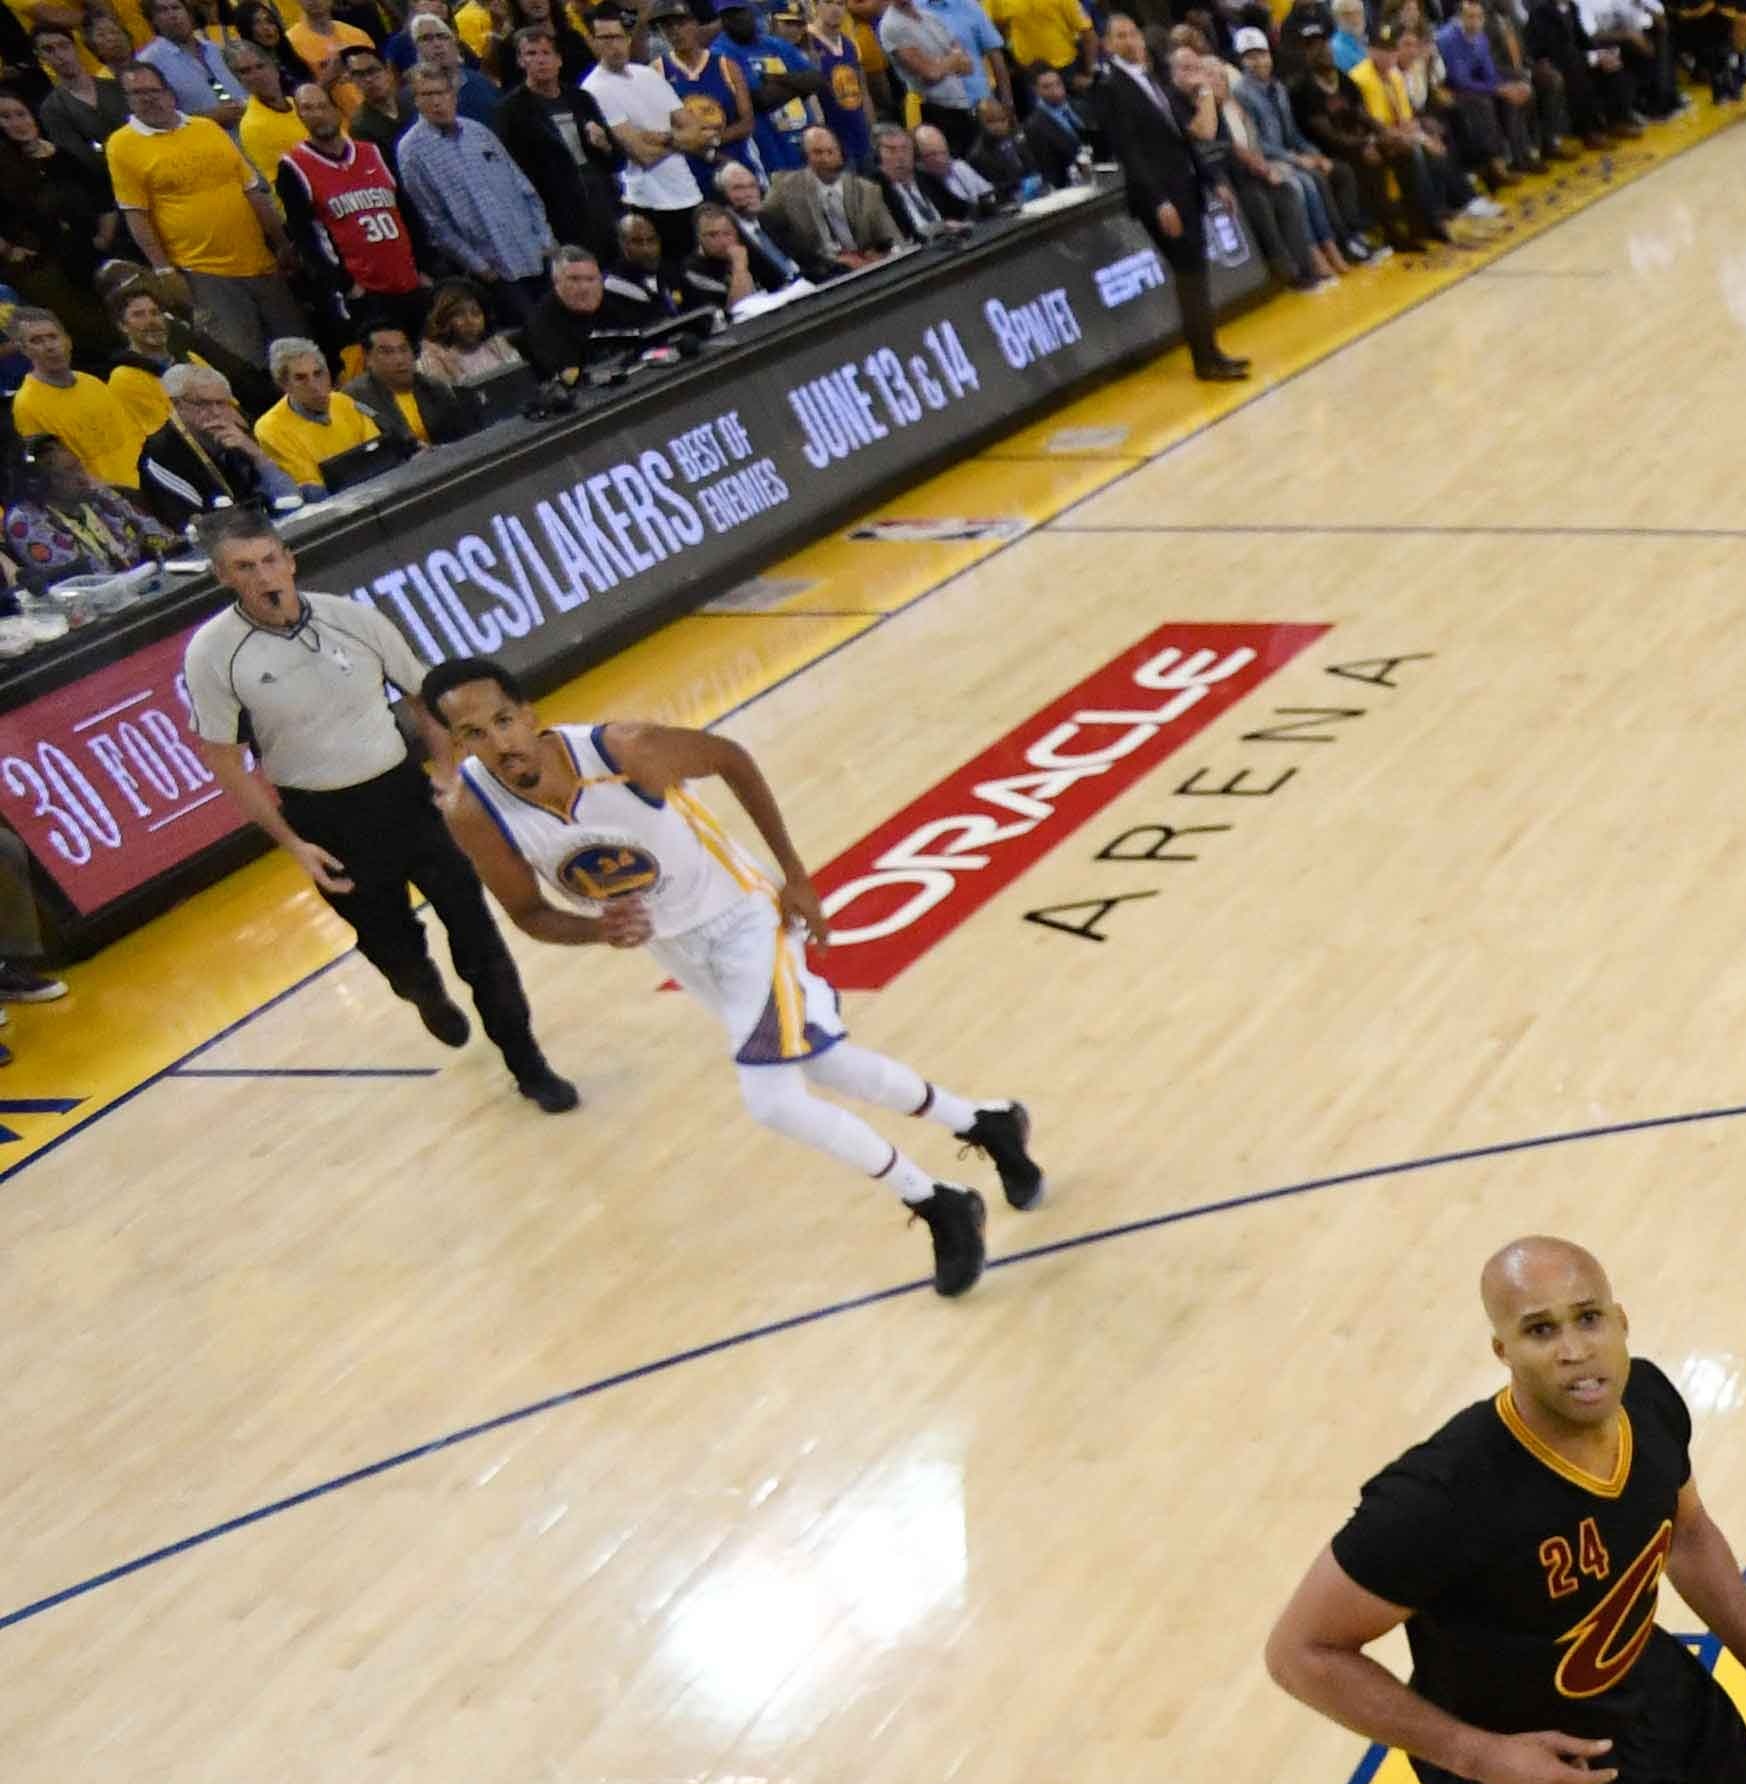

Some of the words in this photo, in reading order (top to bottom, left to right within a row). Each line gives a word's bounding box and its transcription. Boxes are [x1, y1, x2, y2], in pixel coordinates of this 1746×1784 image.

[328, 187, 397, 219] DAVIDSON
[358, 212, 400, 243] 30
[1093, 248, 1167, 310] ESPN
[864, 346, 923, 428] 13
[908, 354, 950, 412] &
[922, 319, 981, 400] 14
[788, 362, 889, 469] JUNE
[696, 457, 790, 533] ENEMIES
[353, 449, 705, 667] TICS/LAKERS
[666, 421, 729, 483] BEST
[716, 409, 754, 460] OF
[1, 740, 122, 866] 30
[86, 708, 215, 818] FOR
[822, 645, 1257, 946] ORACLE
[1022, 651, 1436, 943] ARENA
[1538, 1516, 1611, 1600] 24
